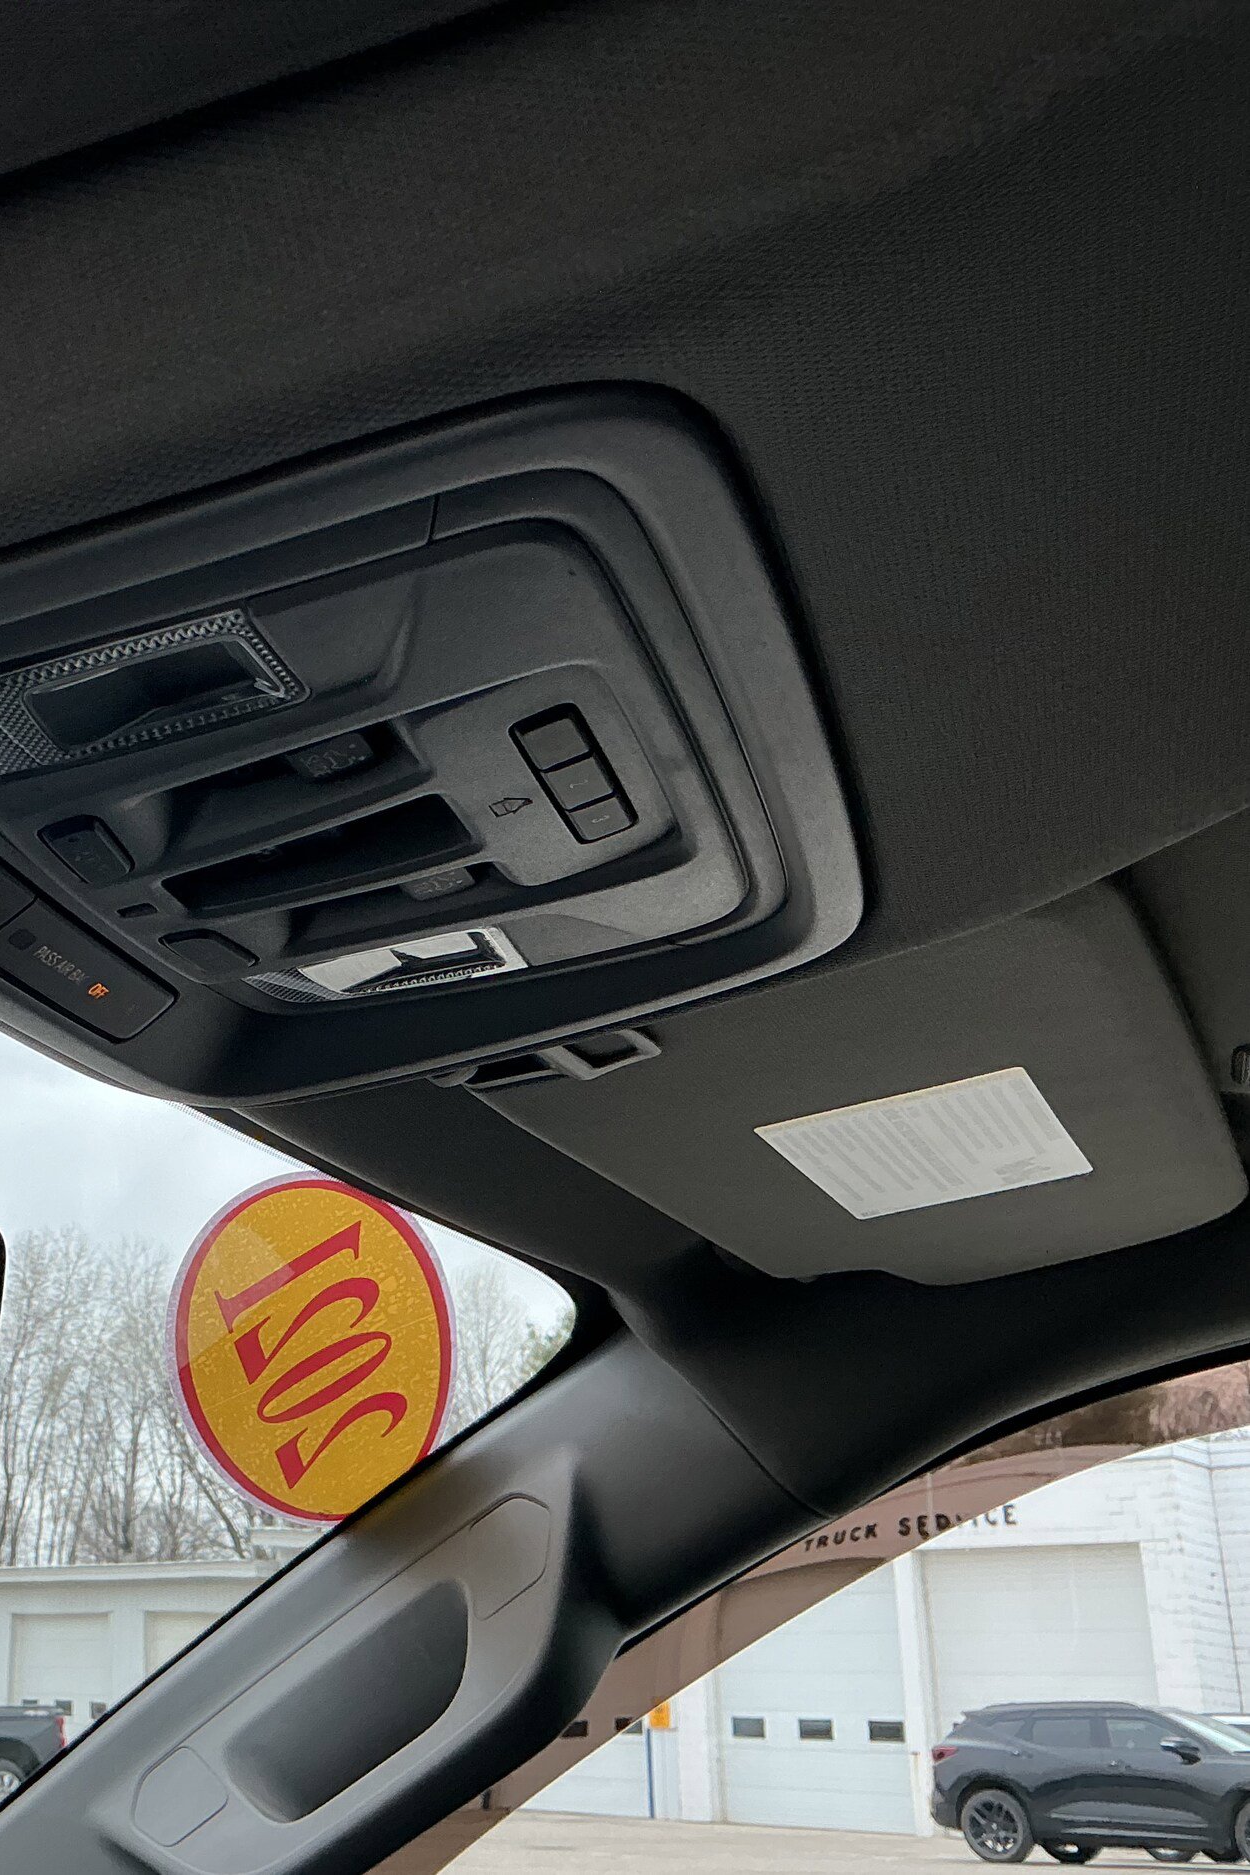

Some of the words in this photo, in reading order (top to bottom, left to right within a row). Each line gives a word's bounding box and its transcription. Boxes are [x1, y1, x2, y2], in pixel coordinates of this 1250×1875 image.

[33, 945, 63, 967] PASS
[54, 960, 76, 976] AIR
[88, 982, 110, 999] OFF
[803, 1522, 879, 1552] TRUCK
